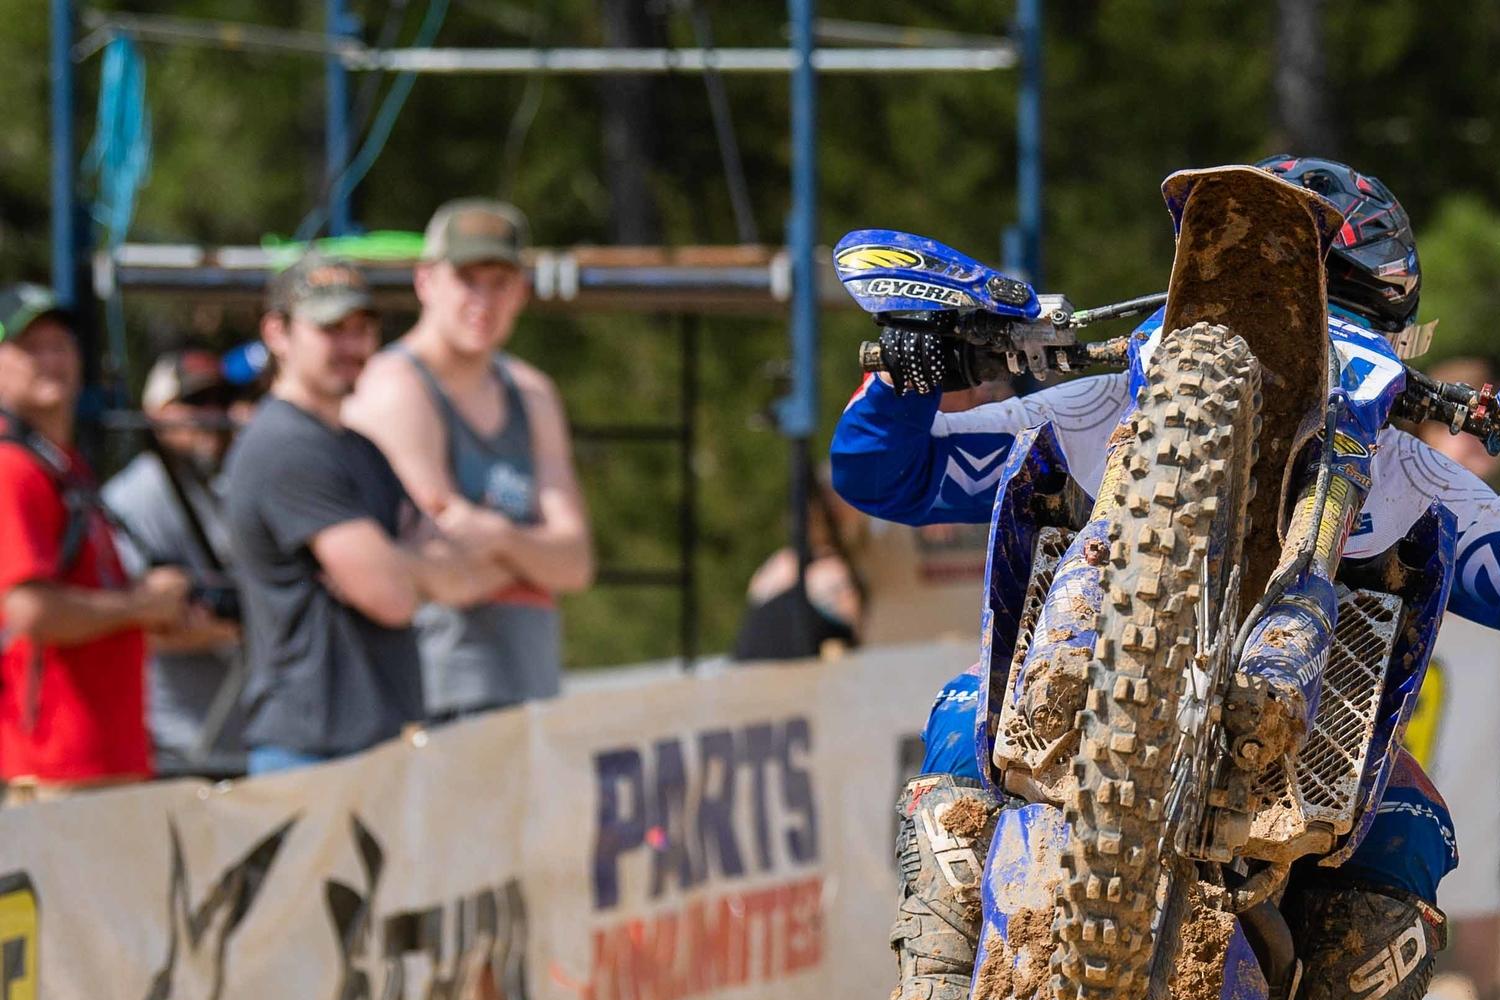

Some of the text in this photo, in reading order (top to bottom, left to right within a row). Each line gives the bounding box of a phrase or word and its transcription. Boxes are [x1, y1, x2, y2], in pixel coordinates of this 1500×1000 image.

[867, 277, 963, 307] CYCRA
[1297, 645, 1330, 687] DUNLO
[592, 716, 818, 911] PARTS
